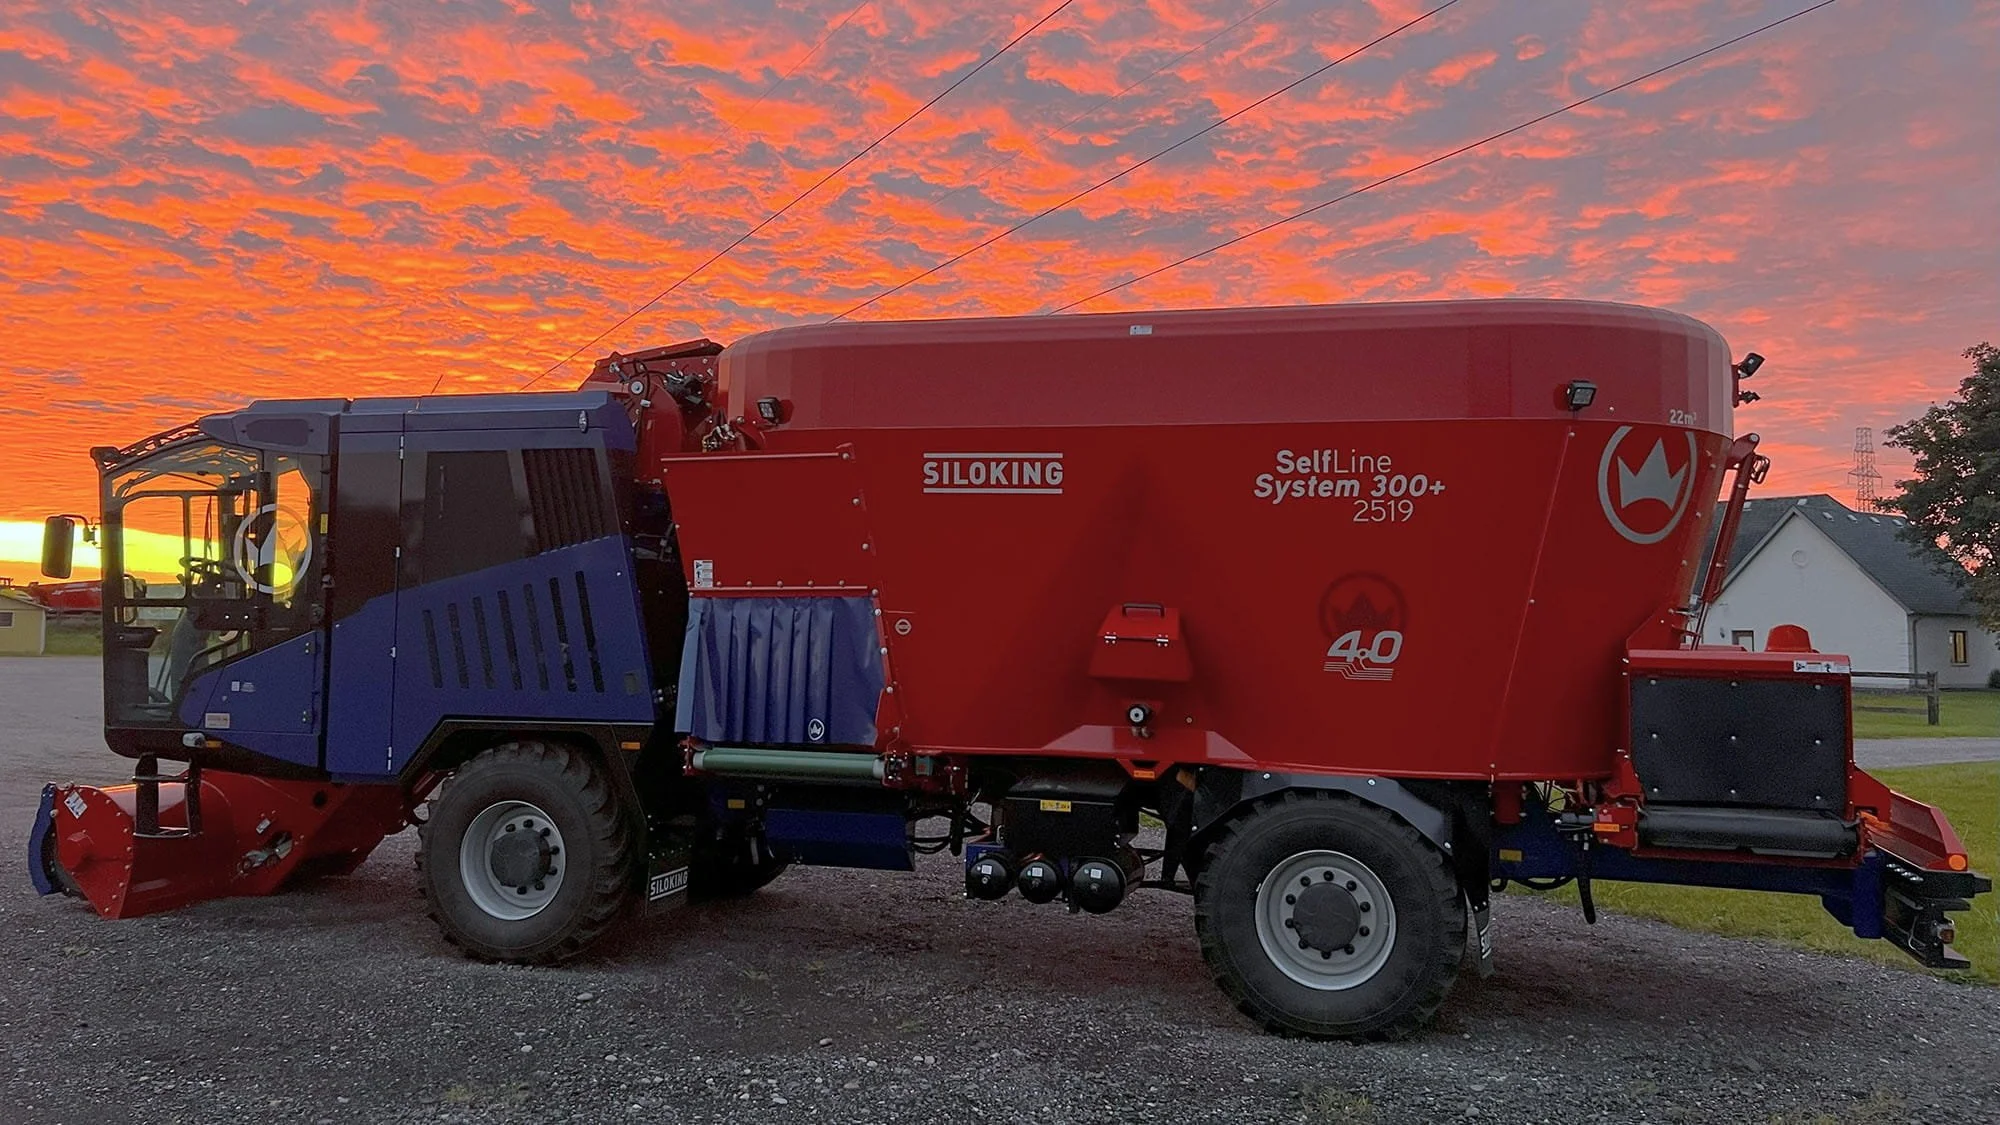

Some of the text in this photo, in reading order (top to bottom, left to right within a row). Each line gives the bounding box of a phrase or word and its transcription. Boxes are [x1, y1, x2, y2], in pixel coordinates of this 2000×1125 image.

[923, 461, 1063, 485] SILOKING
[1276, 449, 1392, 474] SelfLine
[1254, 474, 1446, 505] System 300+
[1353, 500, 1414, 522] 2519
[650, 871, 688, 896] SILOKING
